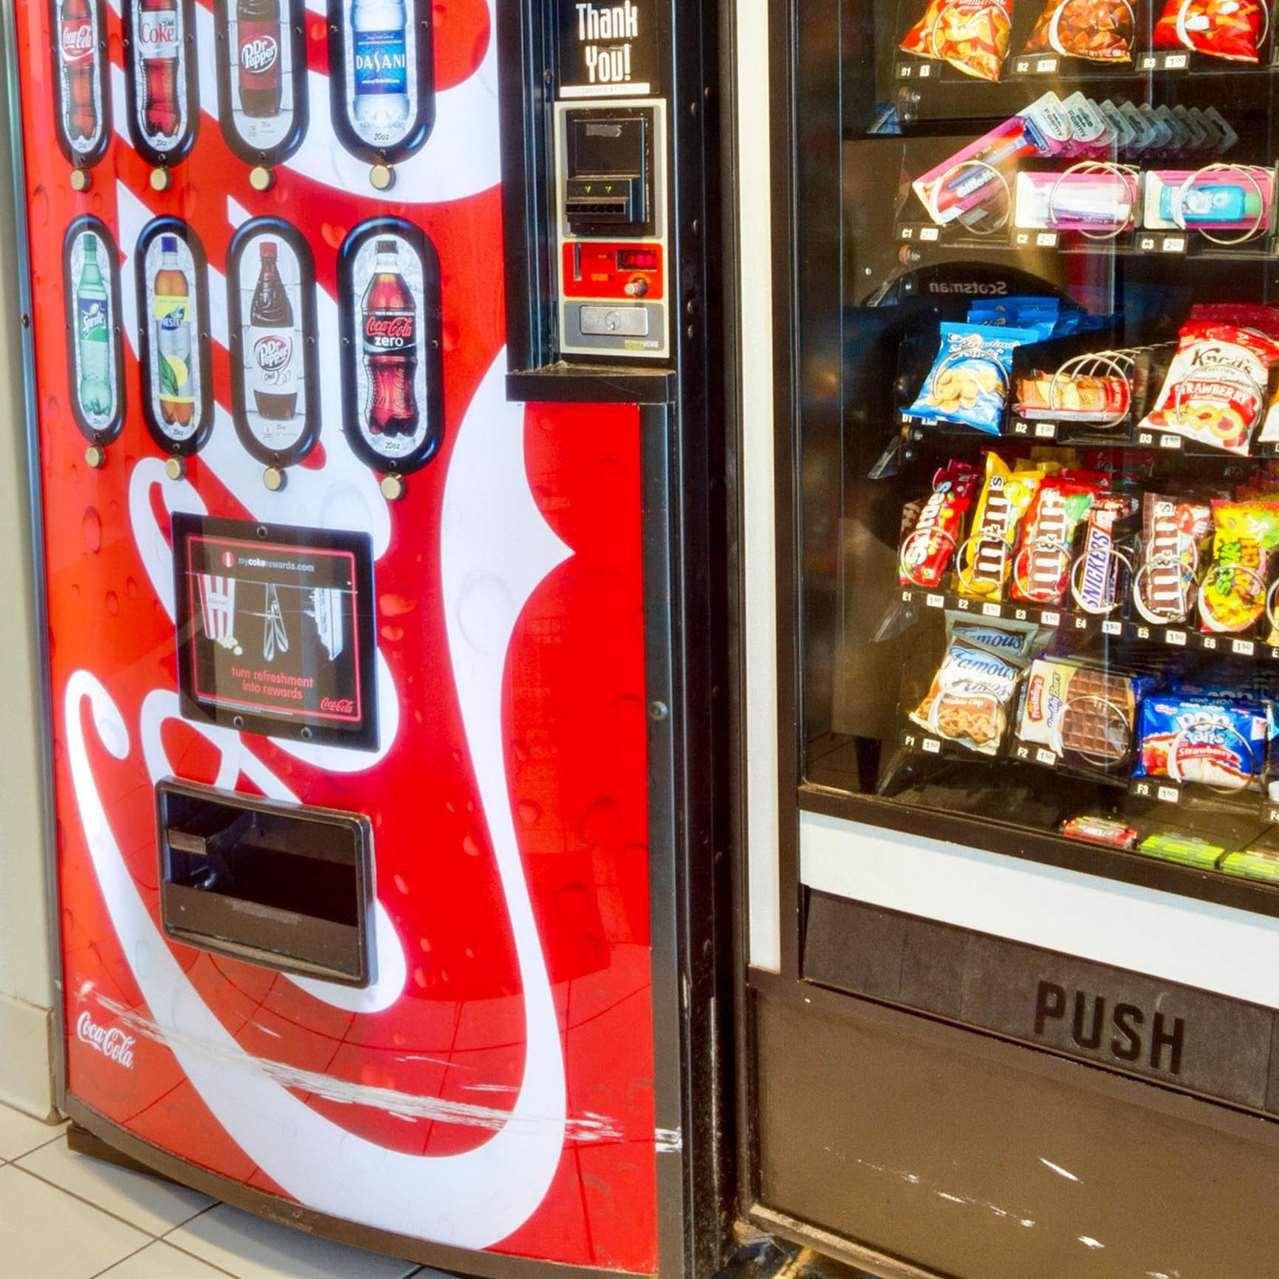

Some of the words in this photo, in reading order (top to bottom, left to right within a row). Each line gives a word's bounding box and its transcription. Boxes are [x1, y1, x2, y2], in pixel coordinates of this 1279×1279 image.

[576, 0, 639, 41] Thank
[139, 22, 175, 45] Coke
[355, 51, 405, 72] DASANI
[585, 43, 632, 83] You!
[901, 228, 913, 239] C1
[364, 316, 414, 337] Coca-Cola
[374, 336, 404, 347] zero
[1015, 422, 1028, 434] D2
[1139, 432, 1152, 444] D3
[1081, 528, 1110, 608] SNICKERS
[241, 680, 261, 693] into
[263, 686, 303, 700] rewards
[254, 671, 314, 688] refreshment
[905, 736, 915, 746] F1
[1034, 979, 1185, 1075] PUSH
[77, 1011, 136, 1068] Coca-Cola
